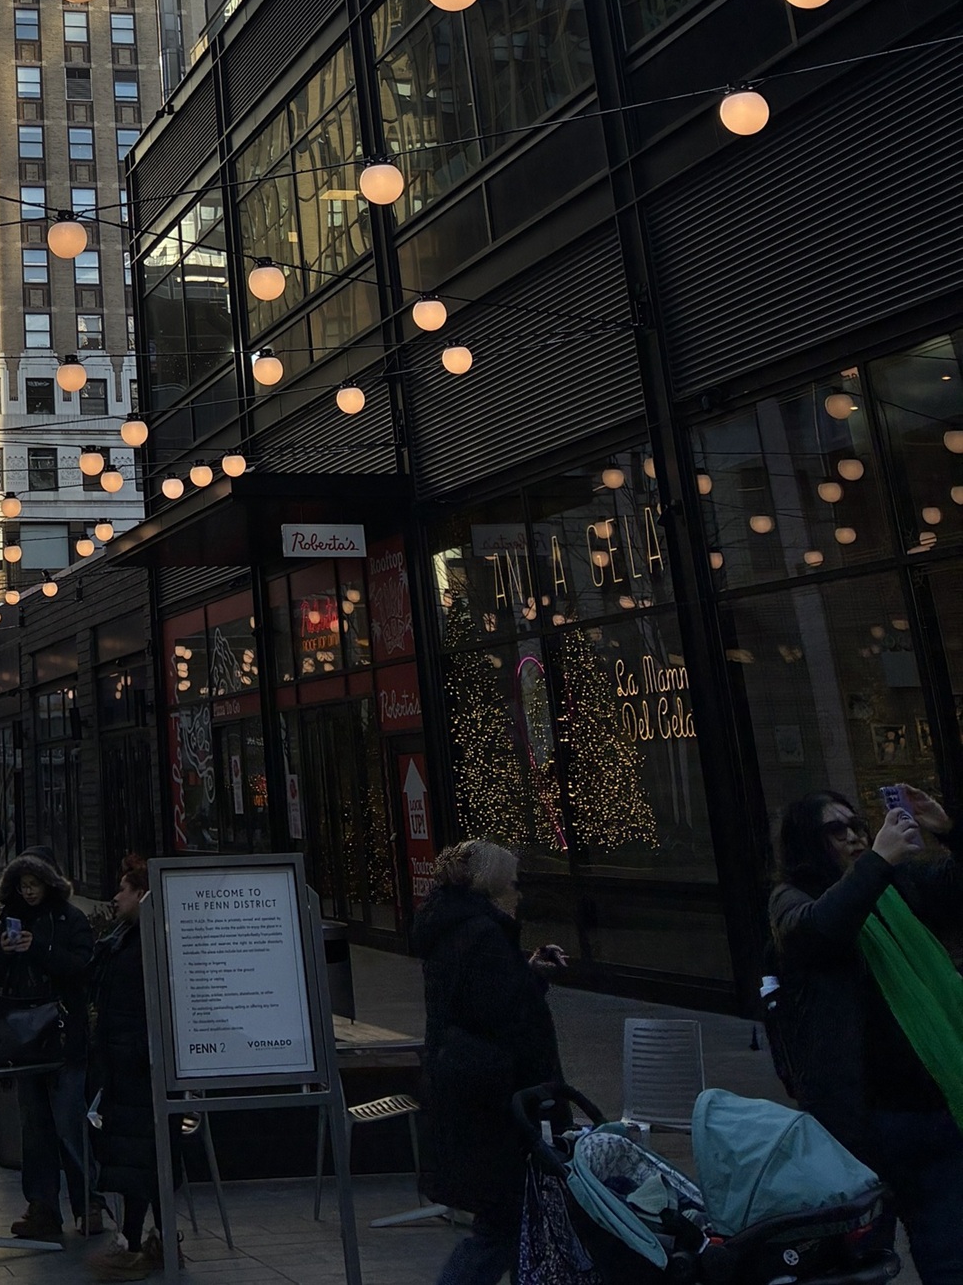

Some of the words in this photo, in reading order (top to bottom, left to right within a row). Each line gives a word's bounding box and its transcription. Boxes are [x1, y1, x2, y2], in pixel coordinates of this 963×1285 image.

[291, 531, 359, 552] Roberta's
[369, 549, 404, 575] Rooftop
[493, 535, 568, 610] ANIA
[615, 659, 639, 698] La
[379, 688, 423, 723] Roberta's
[622, 699, 655, 742] Del
[409, 799, 423, 812] LOOK
[411, 814, 426, 835] UP!
[196, 889, 244, 899] WELCOME
[248, 888, 261, 897] TO
[181, 902, 200, 911] THE
[204, 901, 230, 910] PENN
[234, 899, 276, 909] DISTRICT
[189, 1042, 218, 1055] PENN
[219, 1042, 226, 1053] 2
[247, 1039, 292, 1048] VORNADO
